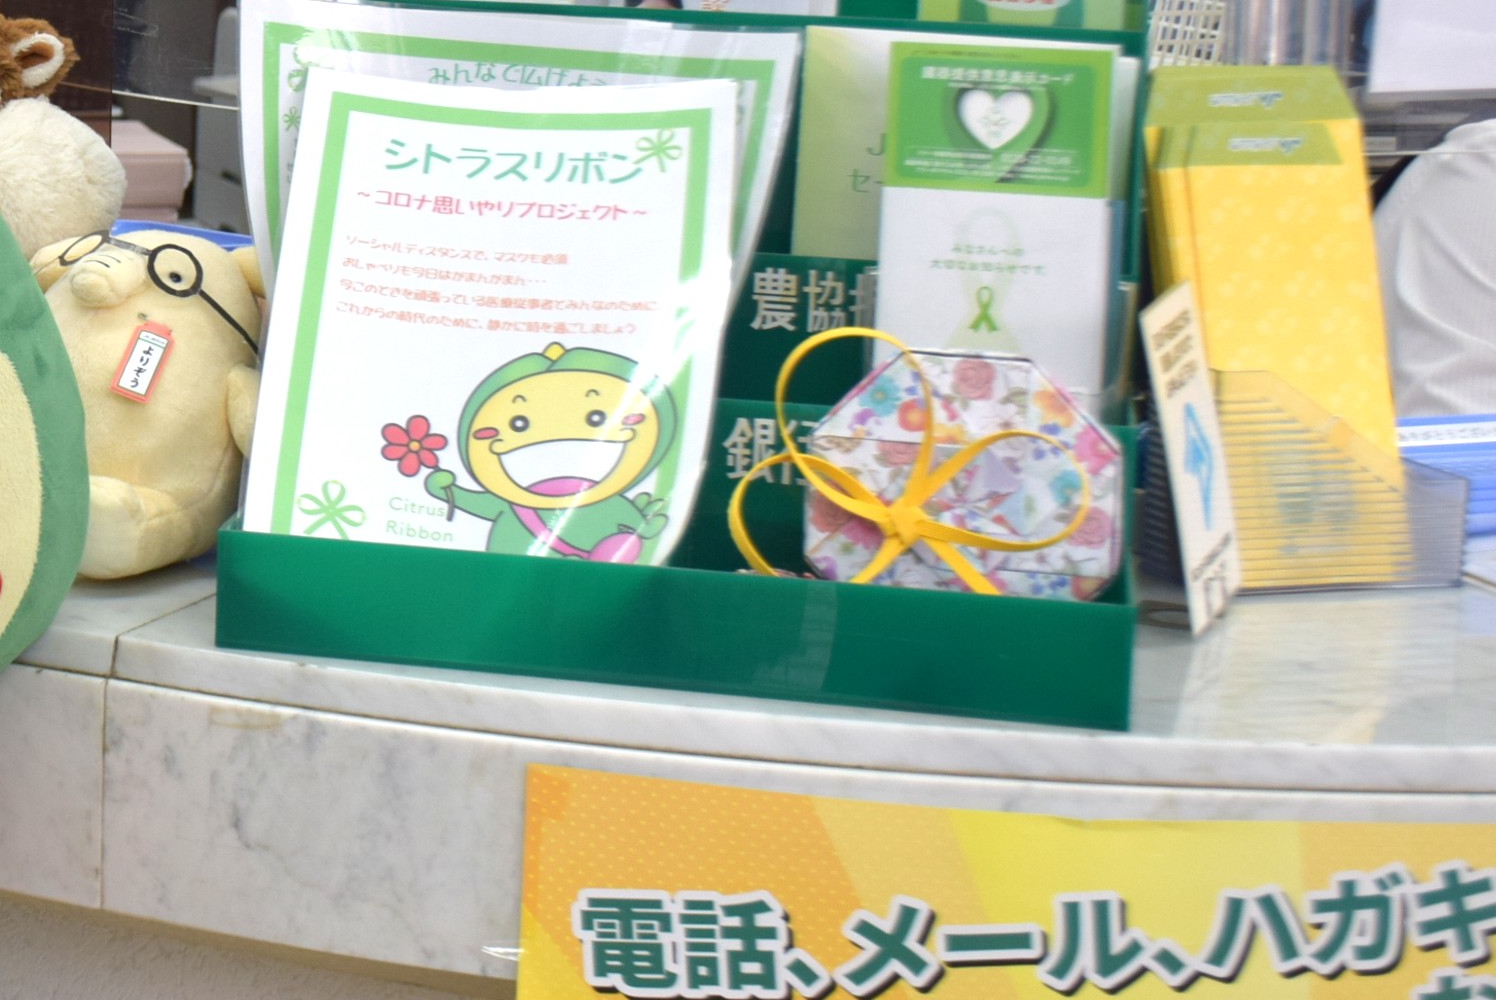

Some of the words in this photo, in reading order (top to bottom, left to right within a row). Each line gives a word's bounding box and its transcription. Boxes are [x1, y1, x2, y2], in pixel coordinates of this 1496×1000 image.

[384, 138, 643, 184] シトラスリボン
[130, 346, 155, 389] よりぞう
[389, 496, 446, 518] Citrus
[386, 519, 455, 542] Ribbon
